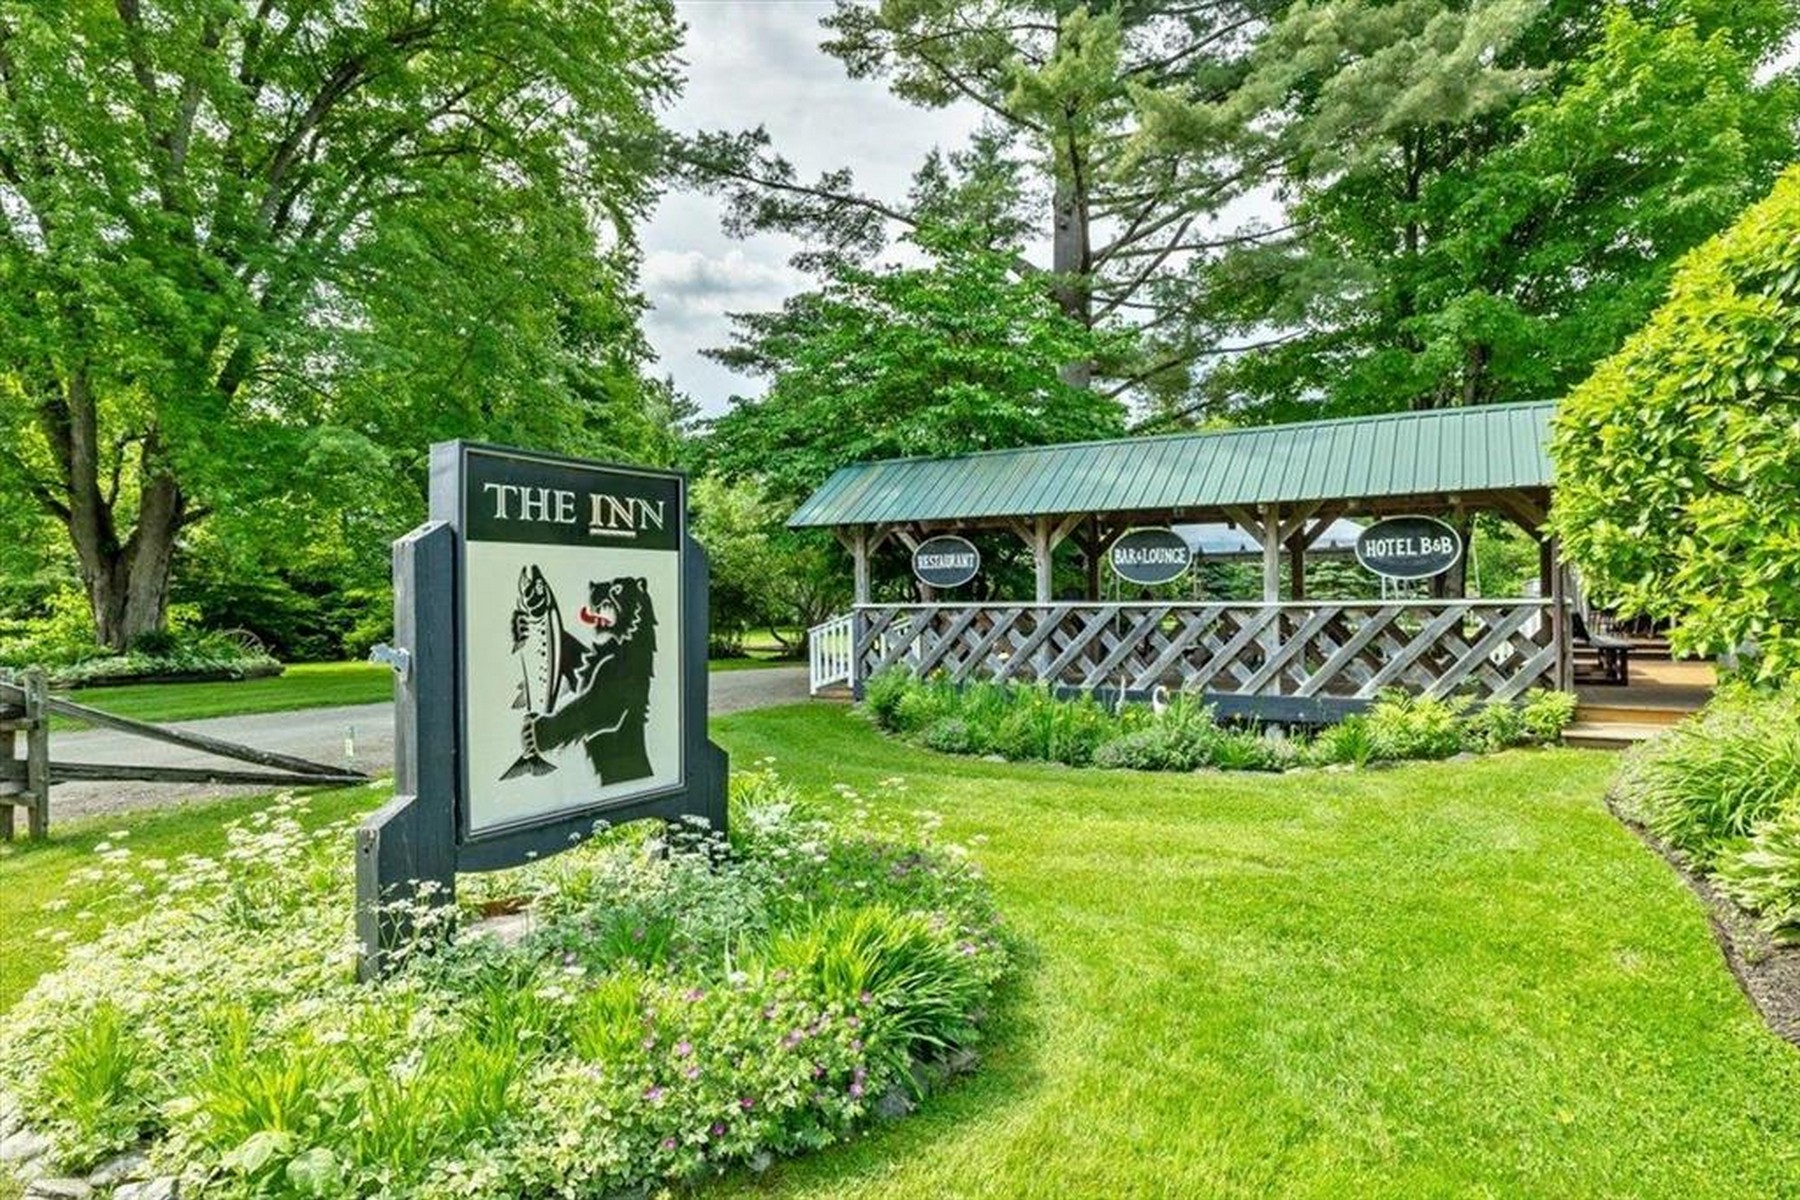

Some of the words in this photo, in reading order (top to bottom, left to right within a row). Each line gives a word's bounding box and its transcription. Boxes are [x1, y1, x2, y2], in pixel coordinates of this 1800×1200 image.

[483, 482, 578, 524] THE
[588, 493, 665, 531] INN
[1365, 538, 1417, 557] HOTEL
[1420, 536, 1453, 555] B&B
[917, 552, 975, 570] RESTAURANT
